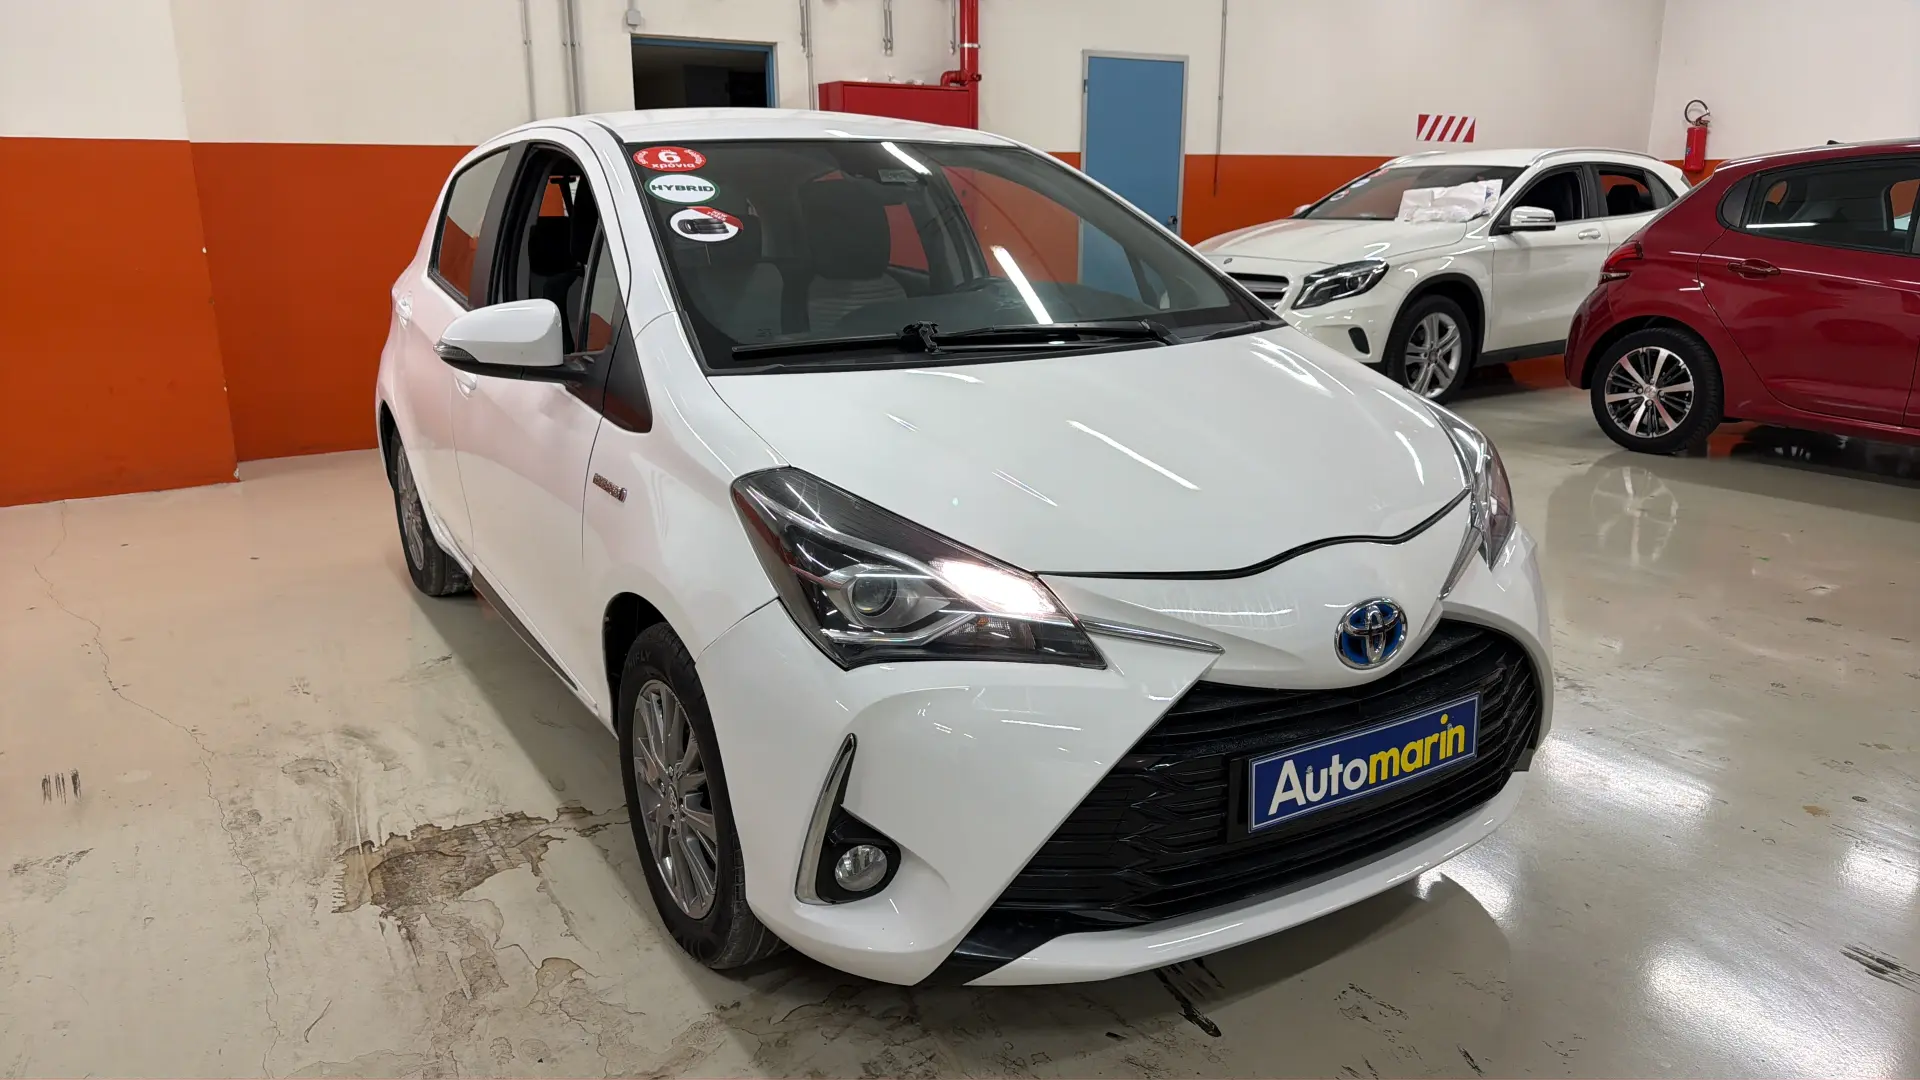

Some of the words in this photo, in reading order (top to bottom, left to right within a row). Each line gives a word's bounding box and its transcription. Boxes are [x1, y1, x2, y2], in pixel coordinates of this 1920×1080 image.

[658, 151, 681, 163] 6
[651, 184, 714, 192] HYBRID
[1268, 714, 1465, 816] Automarin
